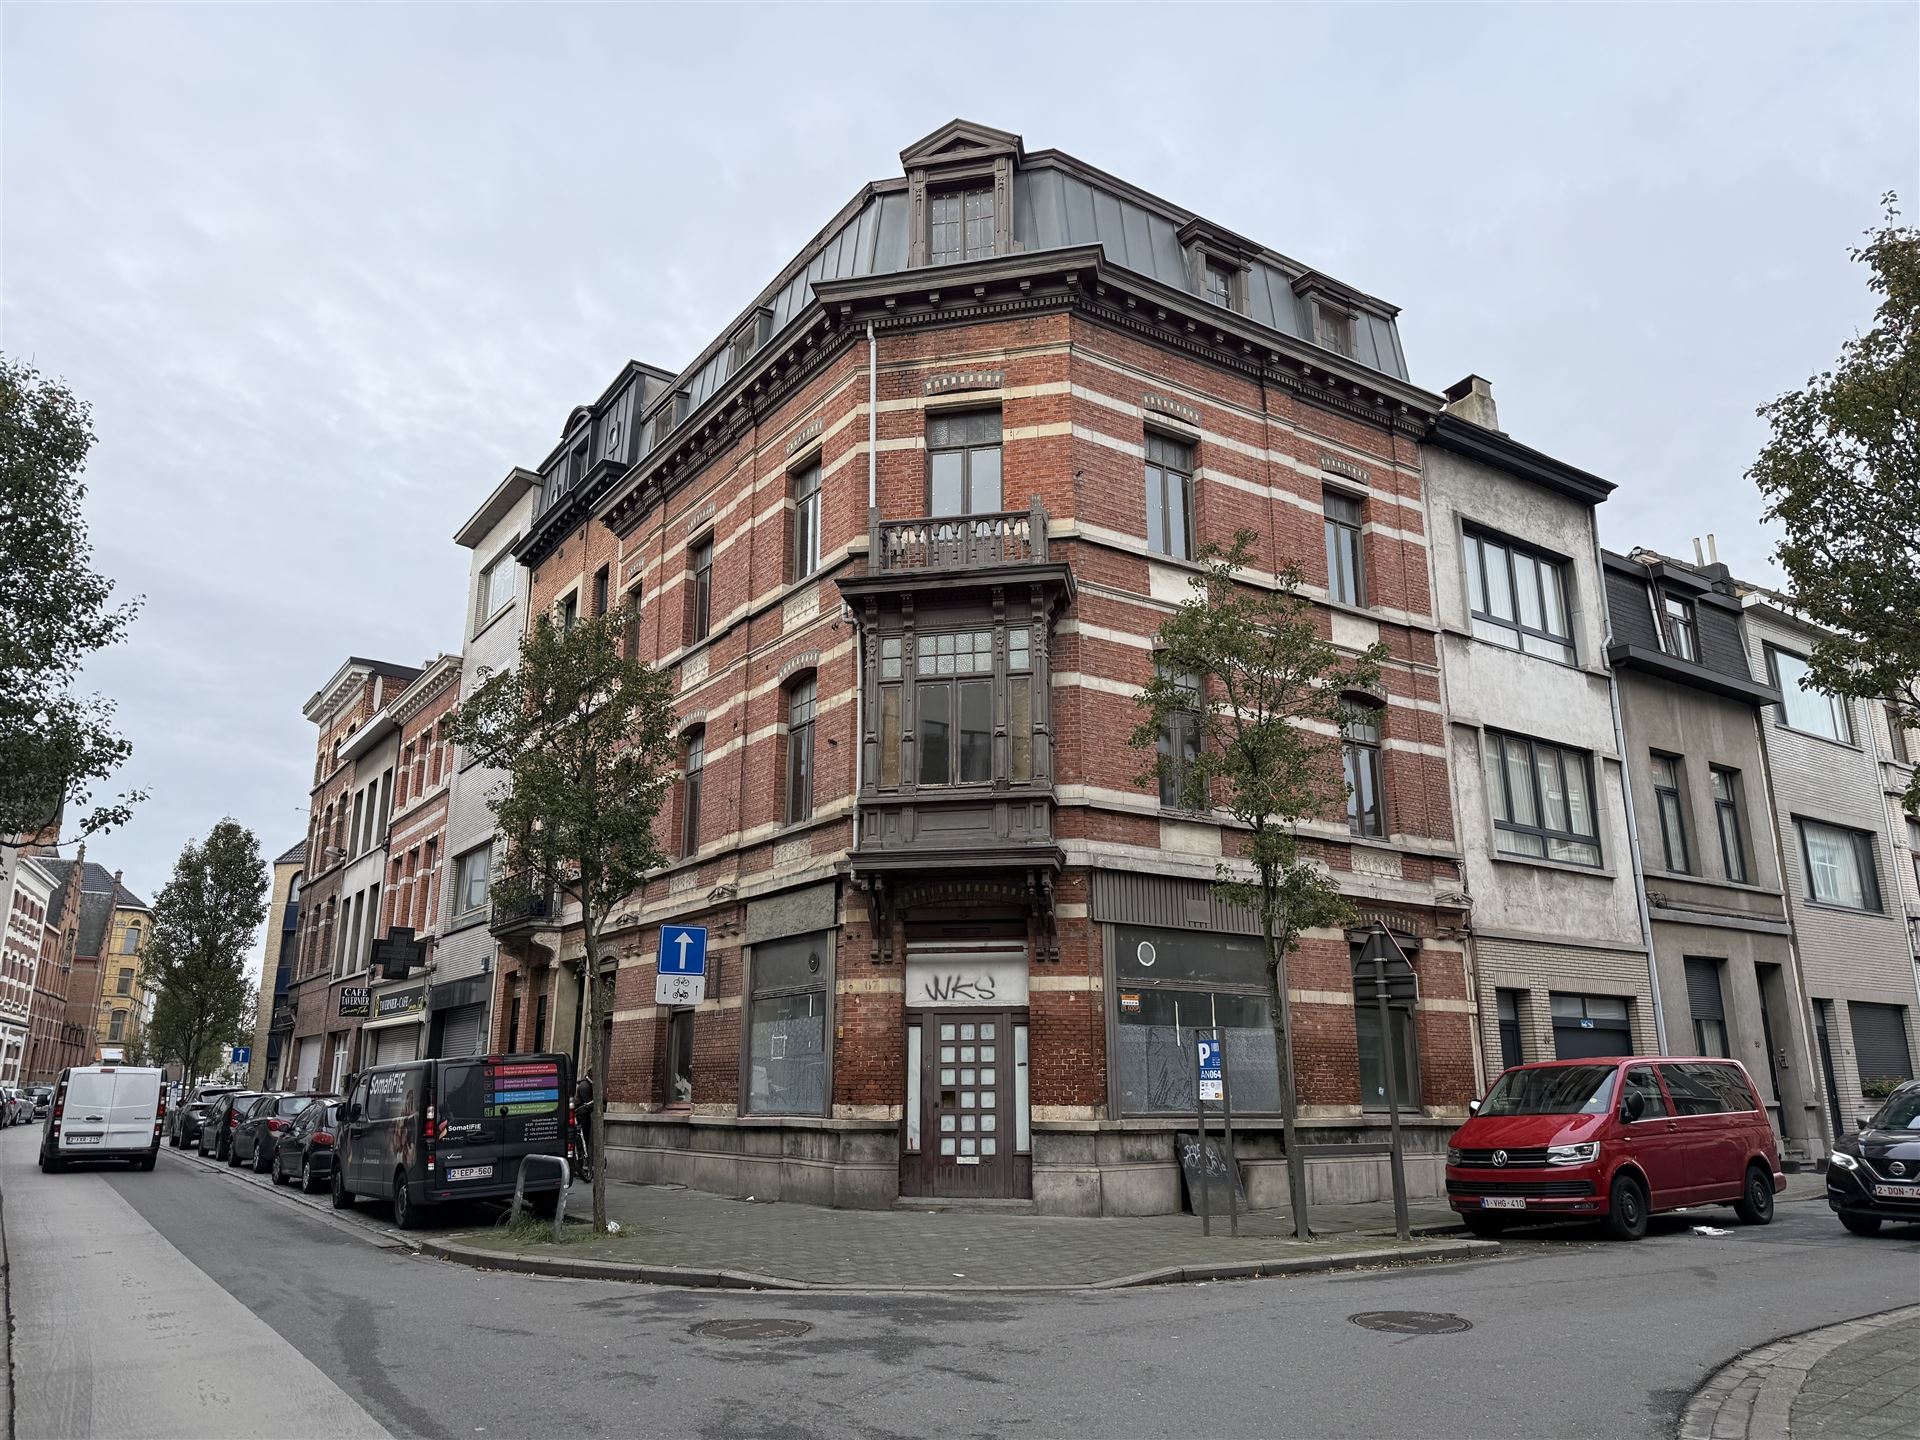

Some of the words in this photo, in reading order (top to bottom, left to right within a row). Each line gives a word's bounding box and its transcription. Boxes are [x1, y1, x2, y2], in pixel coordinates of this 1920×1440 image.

[344, 987, 368, 997] CAFE
[341, 996, 370, 1006] TAVERNIER
[1198, 1043, 1211, 1067] P
[1200, 1070, 1221, 1079] AN064
[448, 1123, 482, 1132] SomatiFIE
